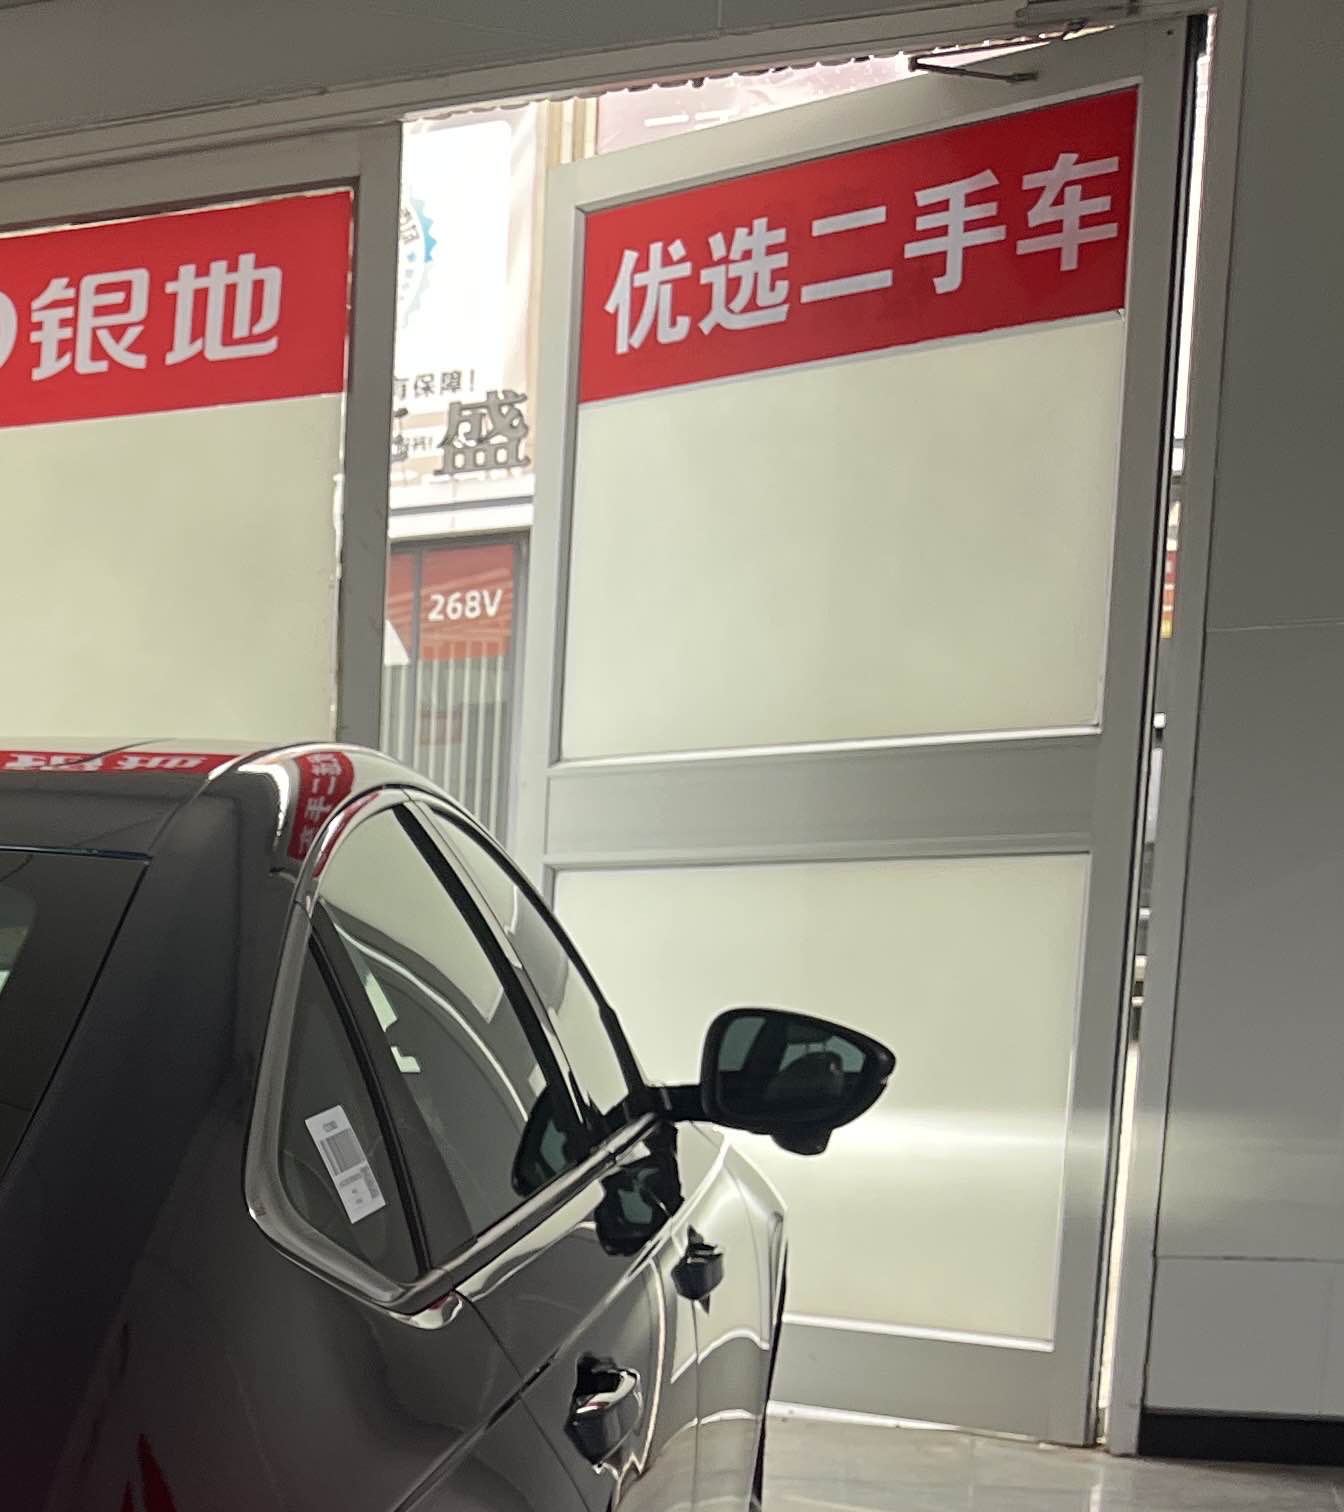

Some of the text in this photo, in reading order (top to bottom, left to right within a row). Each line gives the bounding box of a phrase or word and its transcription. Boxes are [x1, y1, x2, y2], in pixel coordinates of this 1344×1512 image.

[29, 252, 283, 382] 银地
[605, 152, 1120, 356] 优选二手车
[428, 588, 503, 622] 268V
